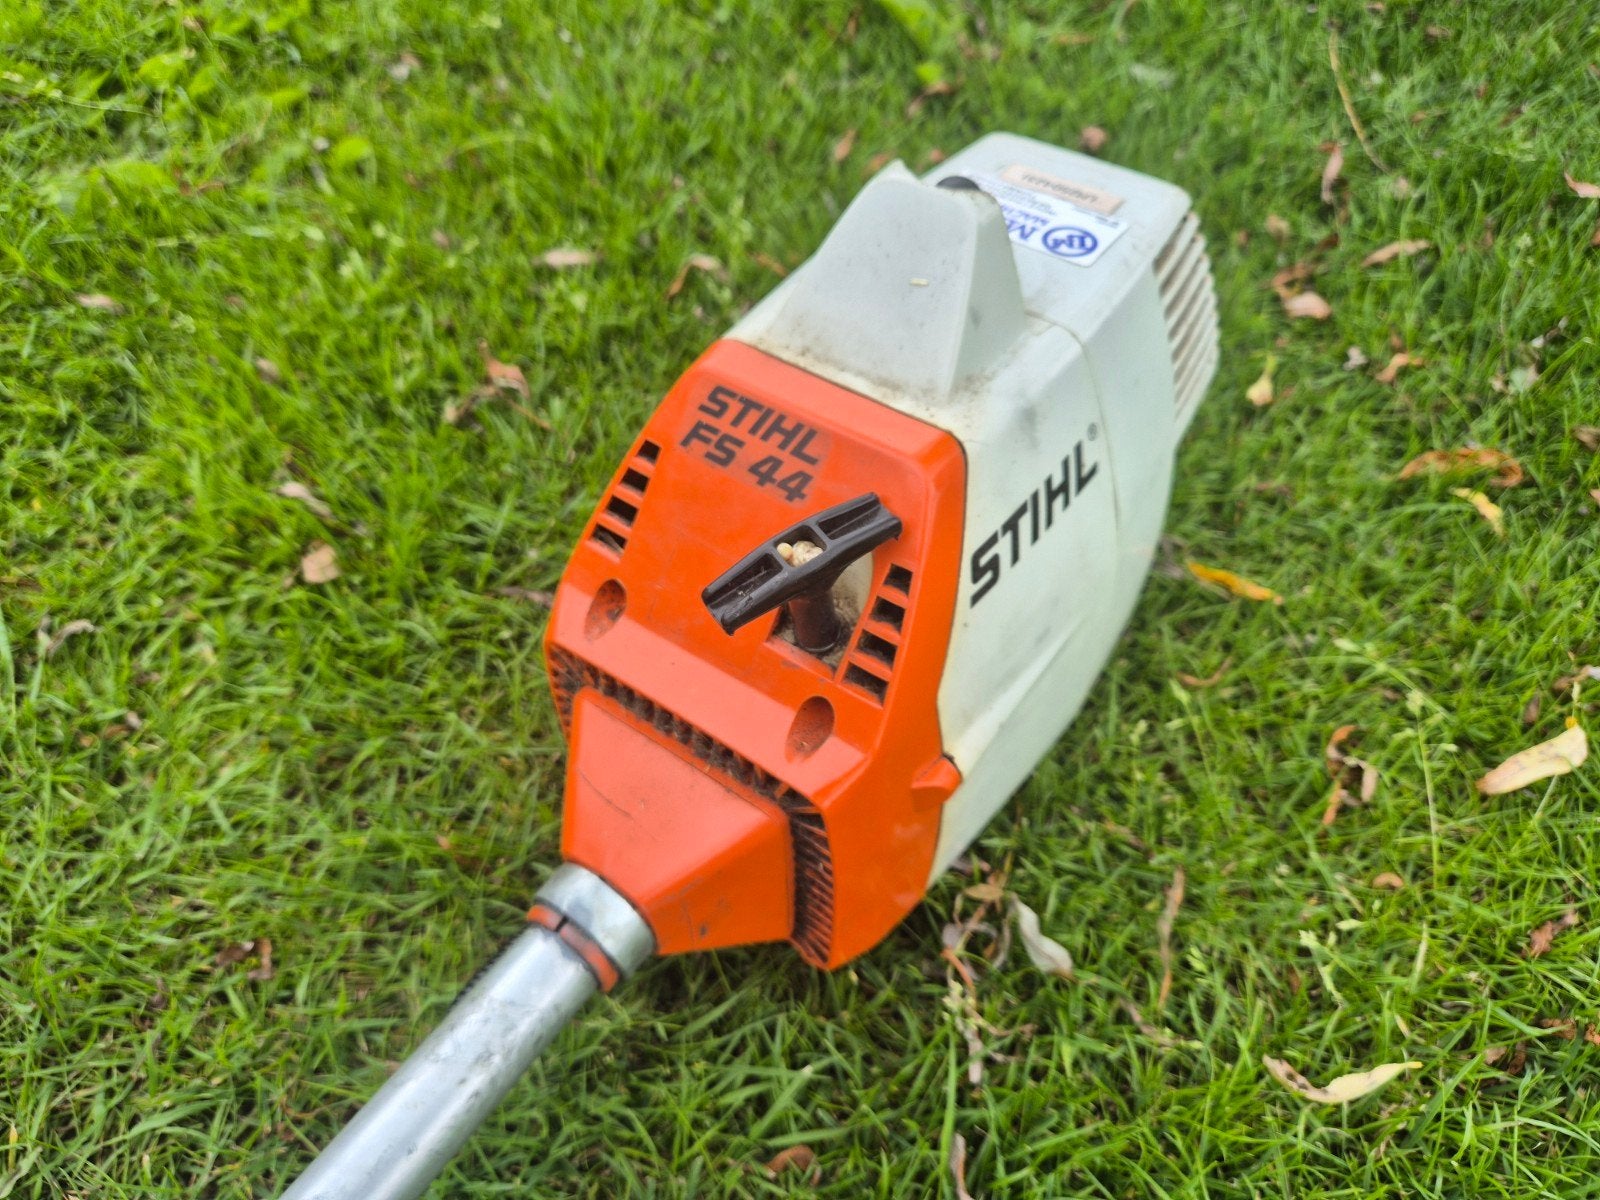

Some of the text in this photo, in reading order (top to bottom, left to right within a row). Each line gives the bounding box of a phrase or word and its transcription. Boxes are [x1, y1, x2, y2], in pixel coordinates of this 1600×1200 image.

[680, 420, 814, 502] FS 44
[698, 385, 819, 466] STIHL
[970, 440, 1098, 609] STIHL
